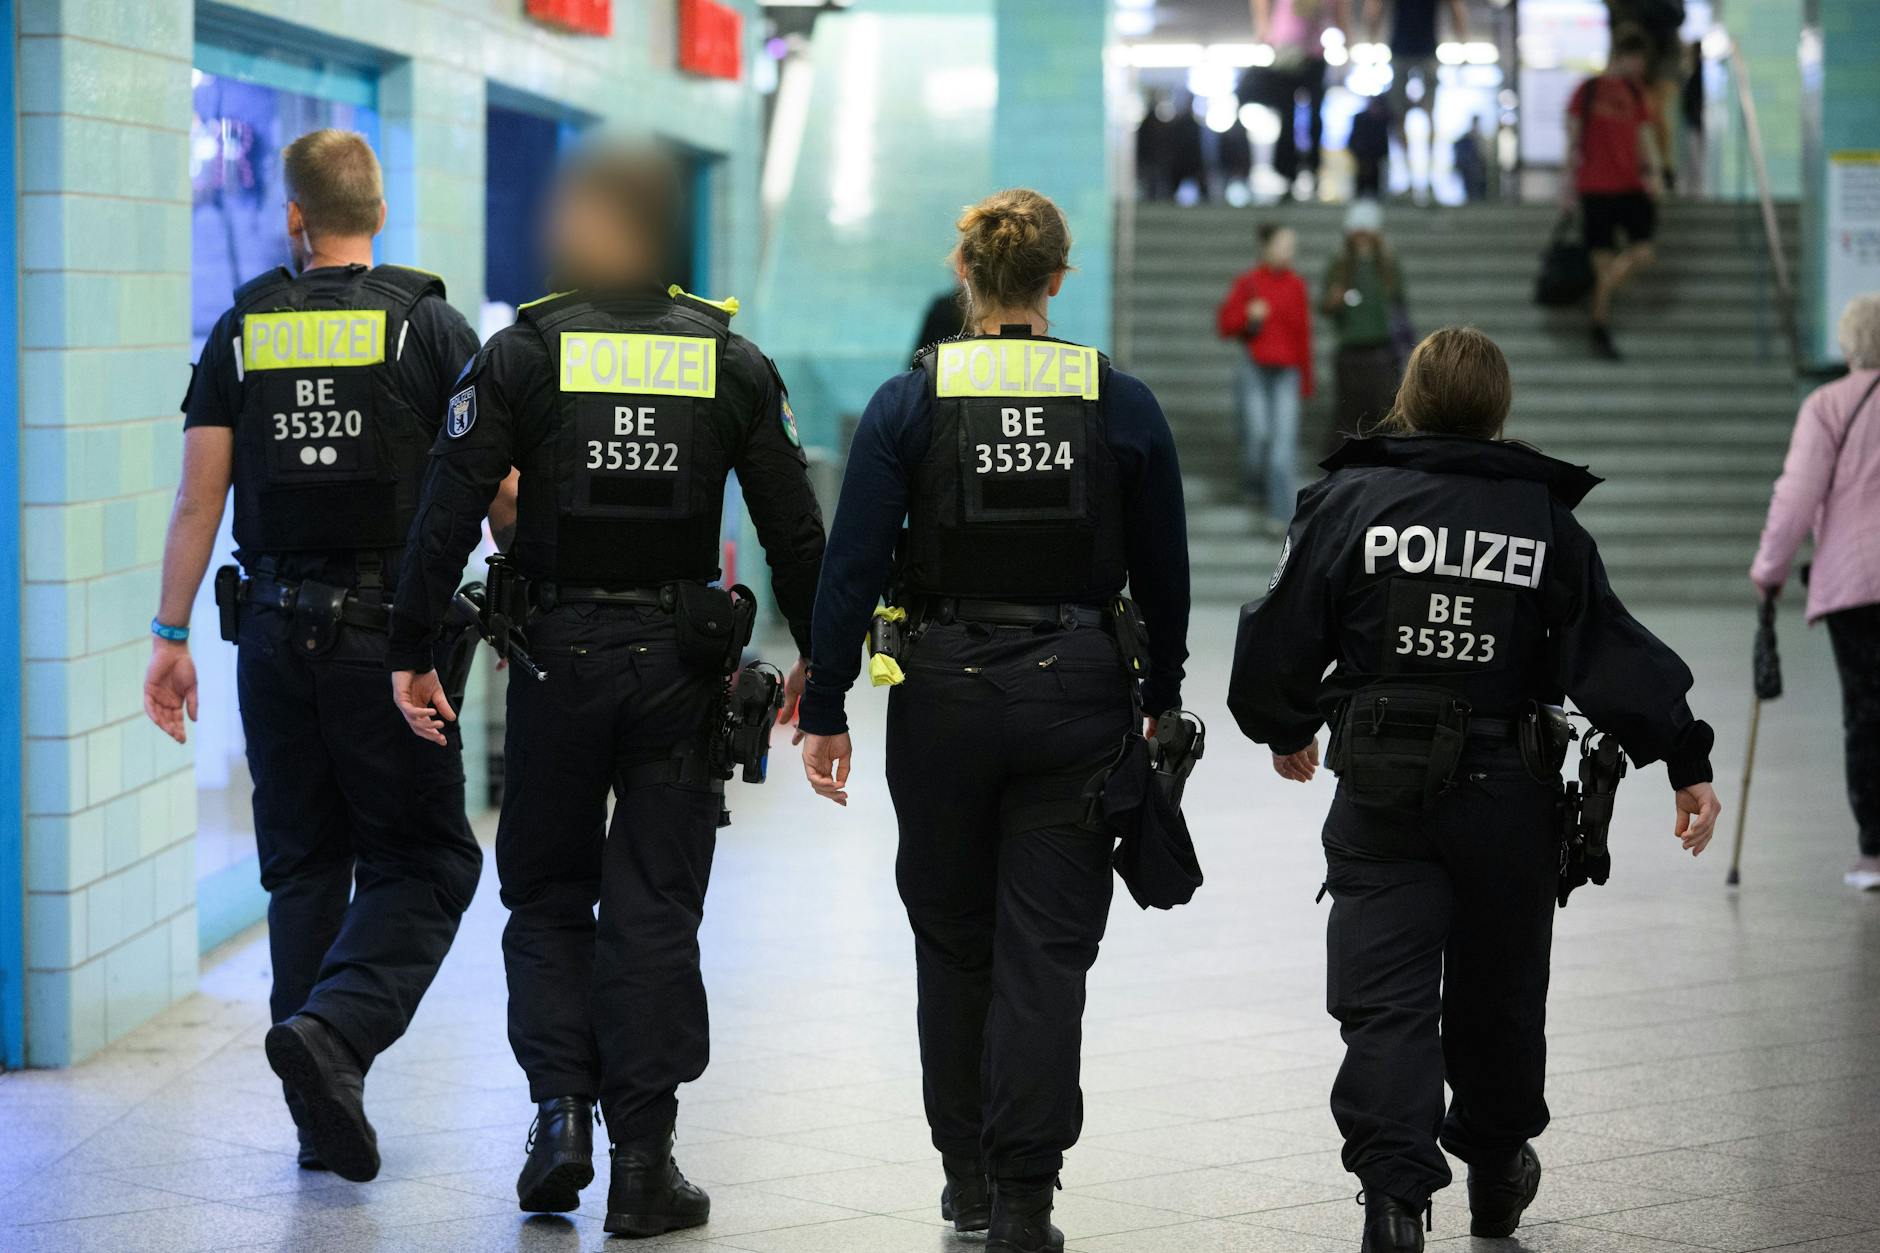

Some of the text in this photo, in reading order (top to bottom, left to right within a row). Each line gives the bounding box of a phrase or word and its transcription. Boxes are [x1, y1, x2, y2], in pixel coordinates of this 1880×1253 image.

[252, 319, 377, 362] POLIZEI
[566, 337, 709, 391] POLIZEI
[942, 345, 1092, 395] POLIZEI
[296, 378, 335, 407] BE
[273, 410, 362, 440] 35320
[614, 406, 656, 436] BE
[1001, 407, 1045, 437] BE
[586, 440, 679, 471] 35322
[976, 441, 1074, 473] 35324
[1364, 525, 1546, 589] POLIZEI
[1428, 593, 1474, 626] BE
[1396, 625, 1496, 663] 35323
